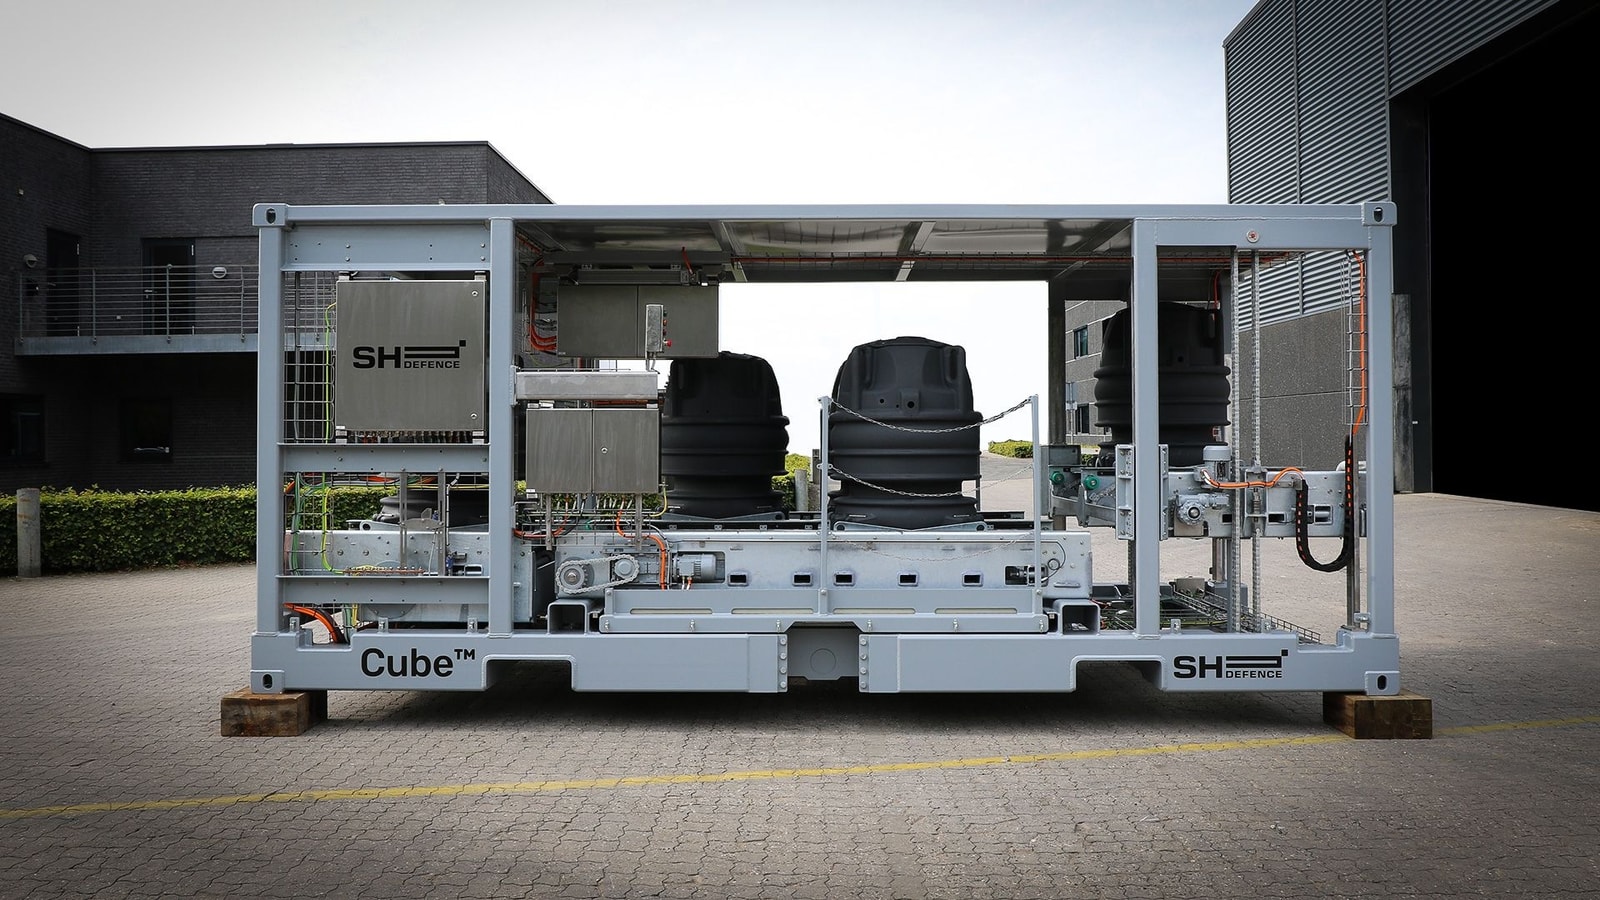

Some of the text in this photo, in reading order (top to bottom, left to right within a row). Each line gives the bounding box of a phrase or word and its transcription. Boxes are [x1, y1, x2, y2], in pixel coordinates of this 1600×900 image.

[353, 346, 460, 369] SH DEFENCE
[1173, 655, 1282, 679] SH DEFENCE
